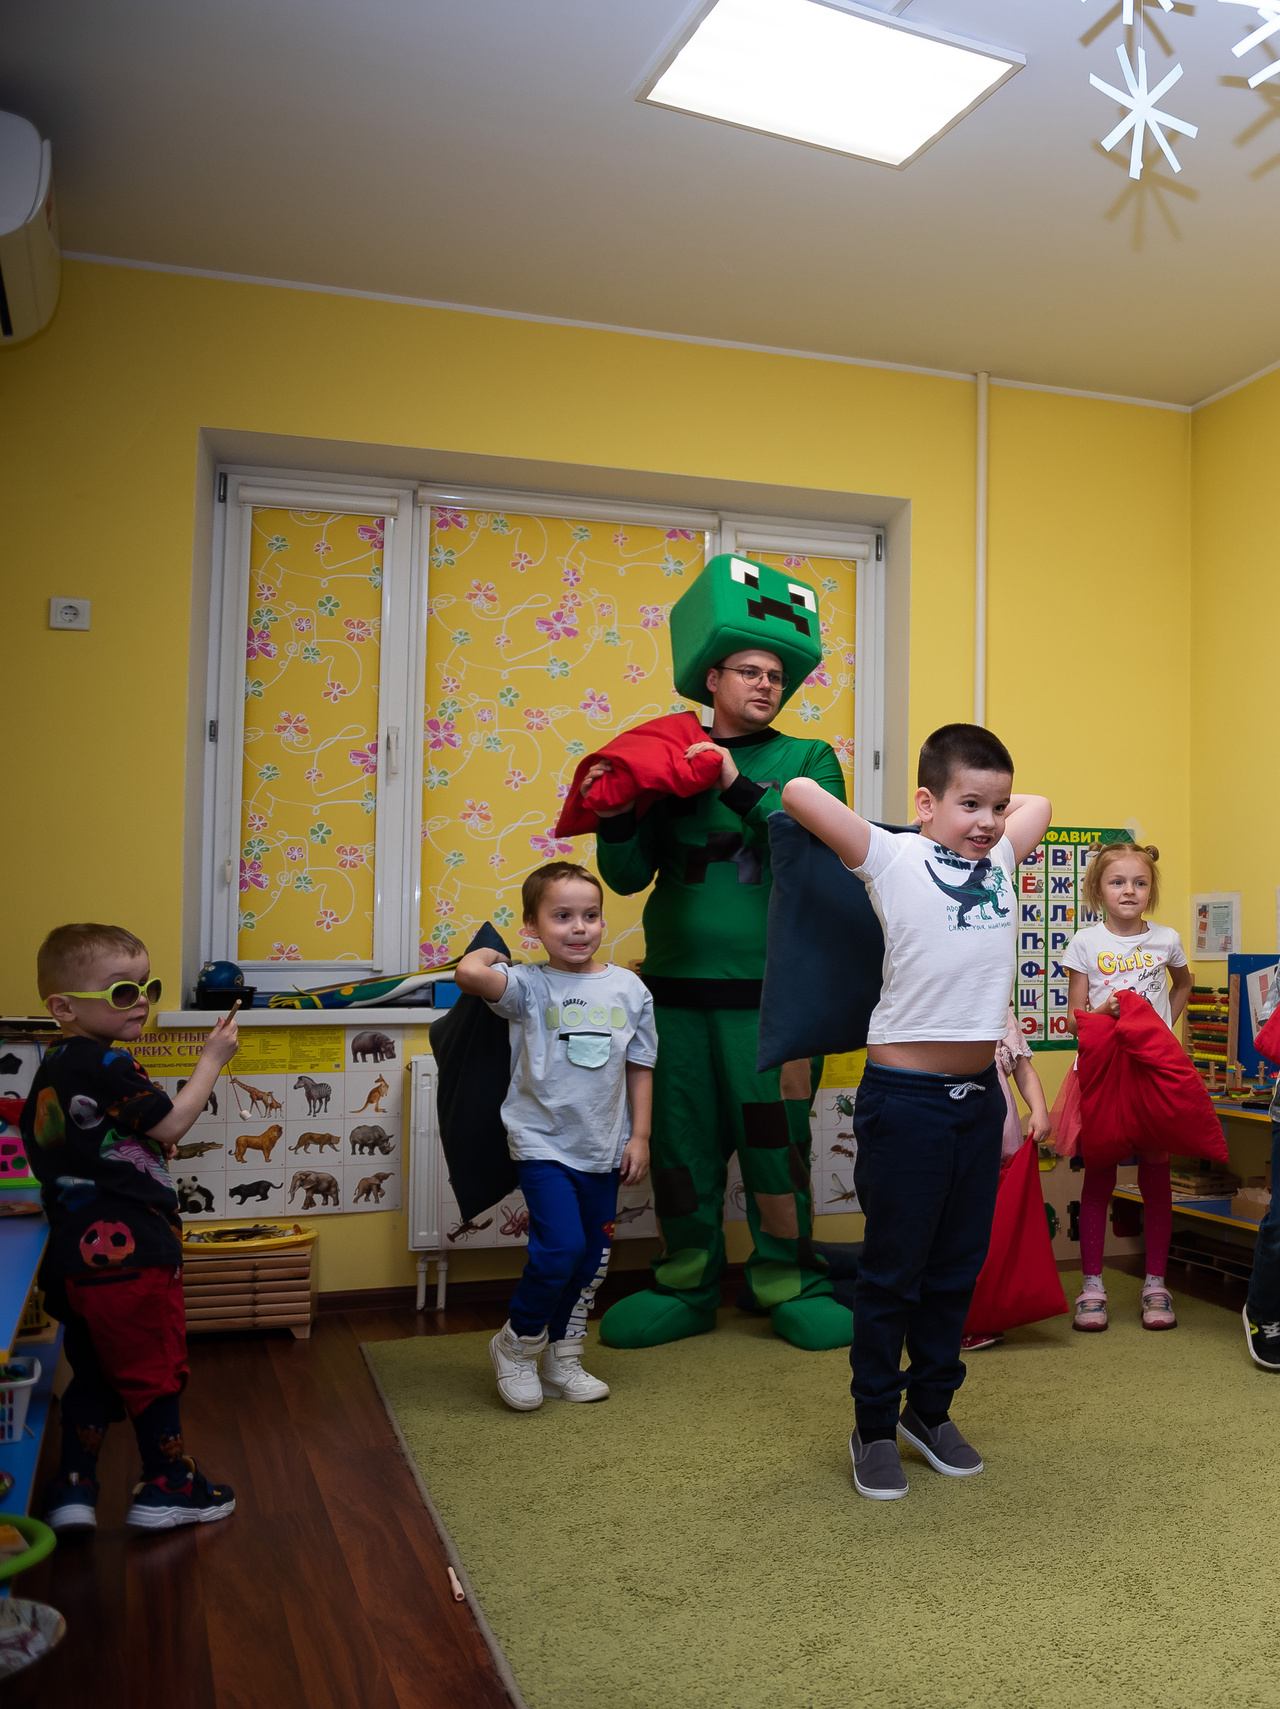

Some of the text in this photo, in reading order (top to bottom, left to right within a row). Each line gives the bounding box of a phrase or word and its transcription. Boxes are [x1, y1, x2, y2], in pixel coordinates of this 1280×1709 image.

[1052, 849, 1067, 866] В
[1022, 873, 1070, 894] Ё Ж
[1022, 904, 1038, 922] К
[1050, 905, 1067, 922] Л
[1021, 932, 1066, 950] П Р
[1021, 961, 1041, 978] Ф
[1097, 945, 1154, 976] Girl's
[562, 998, 587, 1007] CURRENT
[1020, 989, 1068, 1010] Щ Ъ
[1021, 1016, 1068, 1035] Э Ю
[125, 1031, 210, 1043] ИВОТНЫЕ
[117, 1045, 173, 1057] АРКИХ
